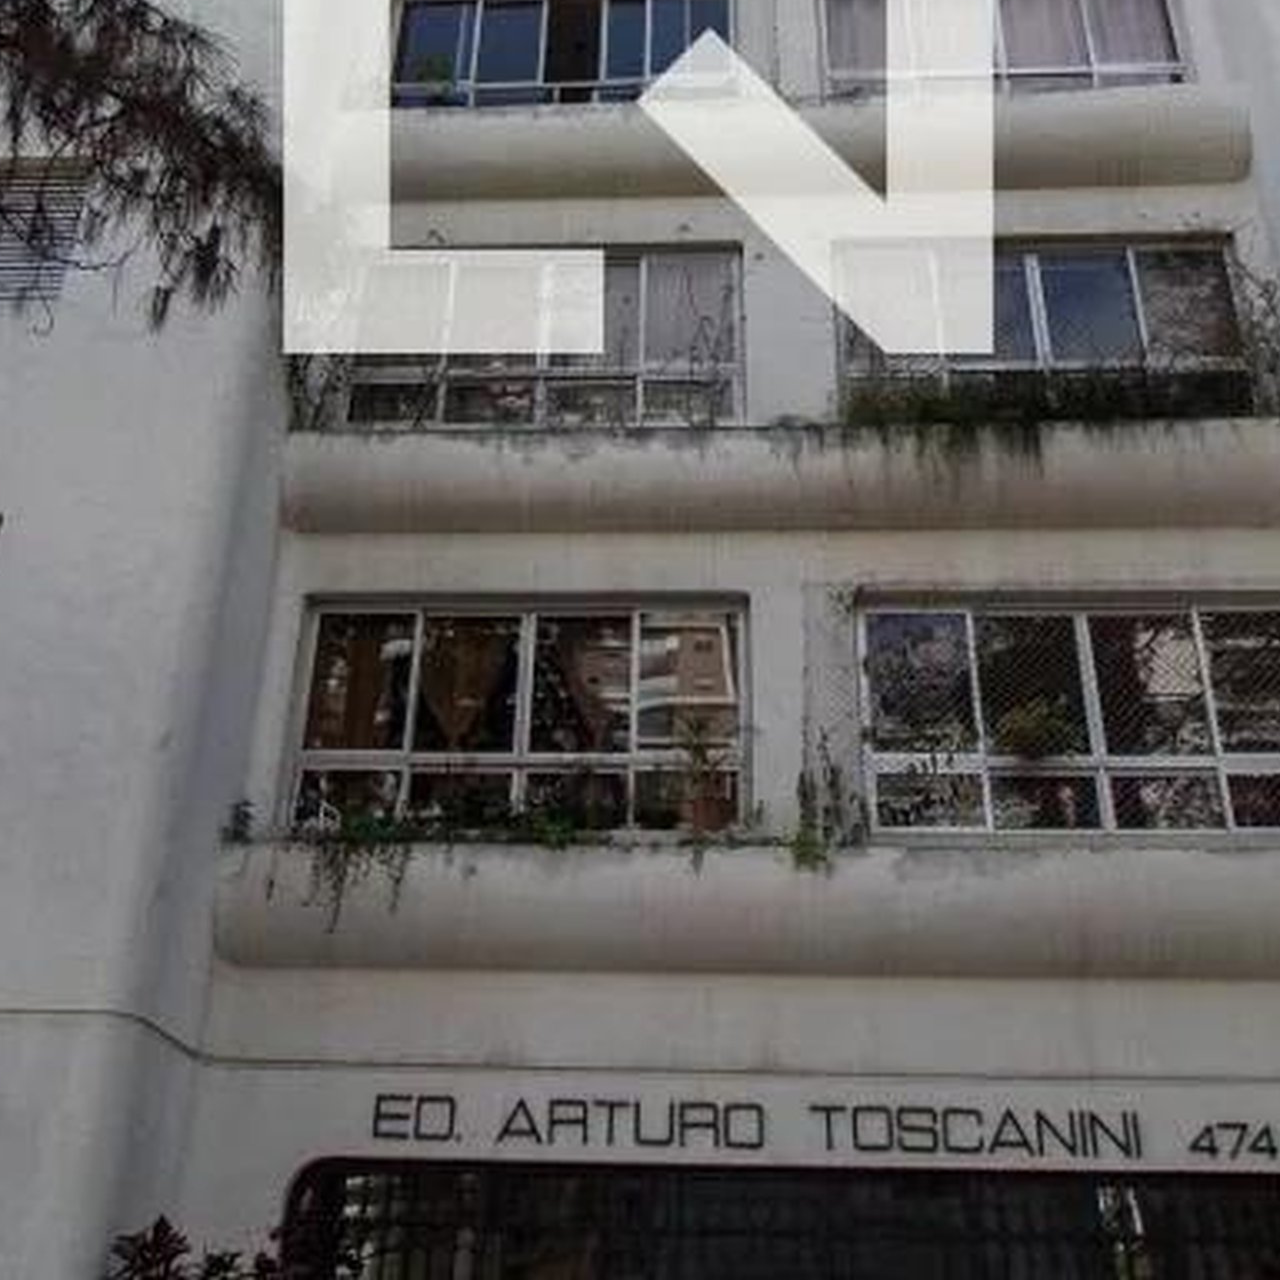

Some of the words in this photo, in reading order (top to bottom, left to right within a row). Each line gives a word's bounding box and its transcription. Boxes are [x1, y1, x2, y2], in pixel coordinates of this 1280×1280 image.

[371, 1093, 463, 1143] ED.
[495, 1097, 766, 1151] ARTURO
[808, 1102, 1143, 1159] TOSCANINI
[1187, 1121, 1279, 1160] 474
